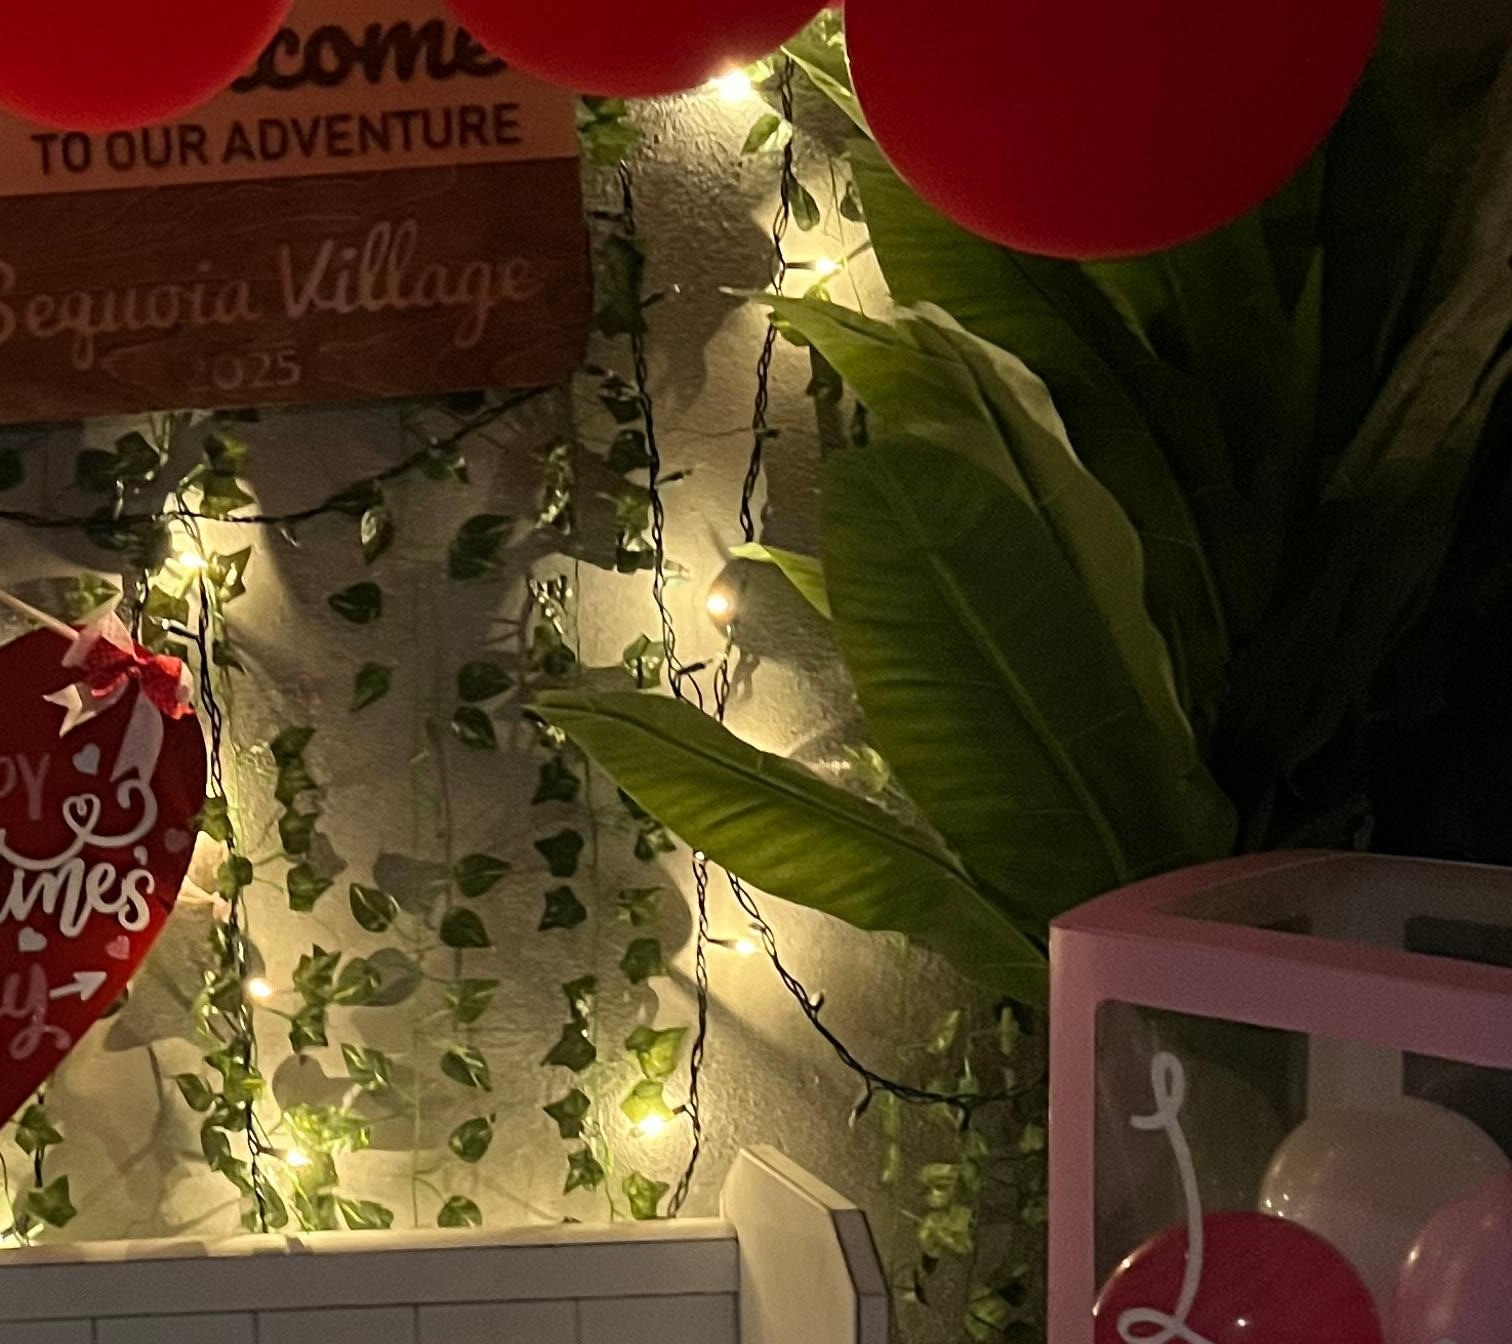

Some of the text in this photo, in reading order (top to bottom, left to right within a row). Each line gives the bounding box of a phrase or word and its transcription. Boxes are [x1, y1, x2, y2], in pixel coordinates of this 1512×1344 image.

[230, 19, 509, 93] come
[30, 102, 522, 175] TO OUR ADVENTURE
[277, 219, 545, 351] Village
